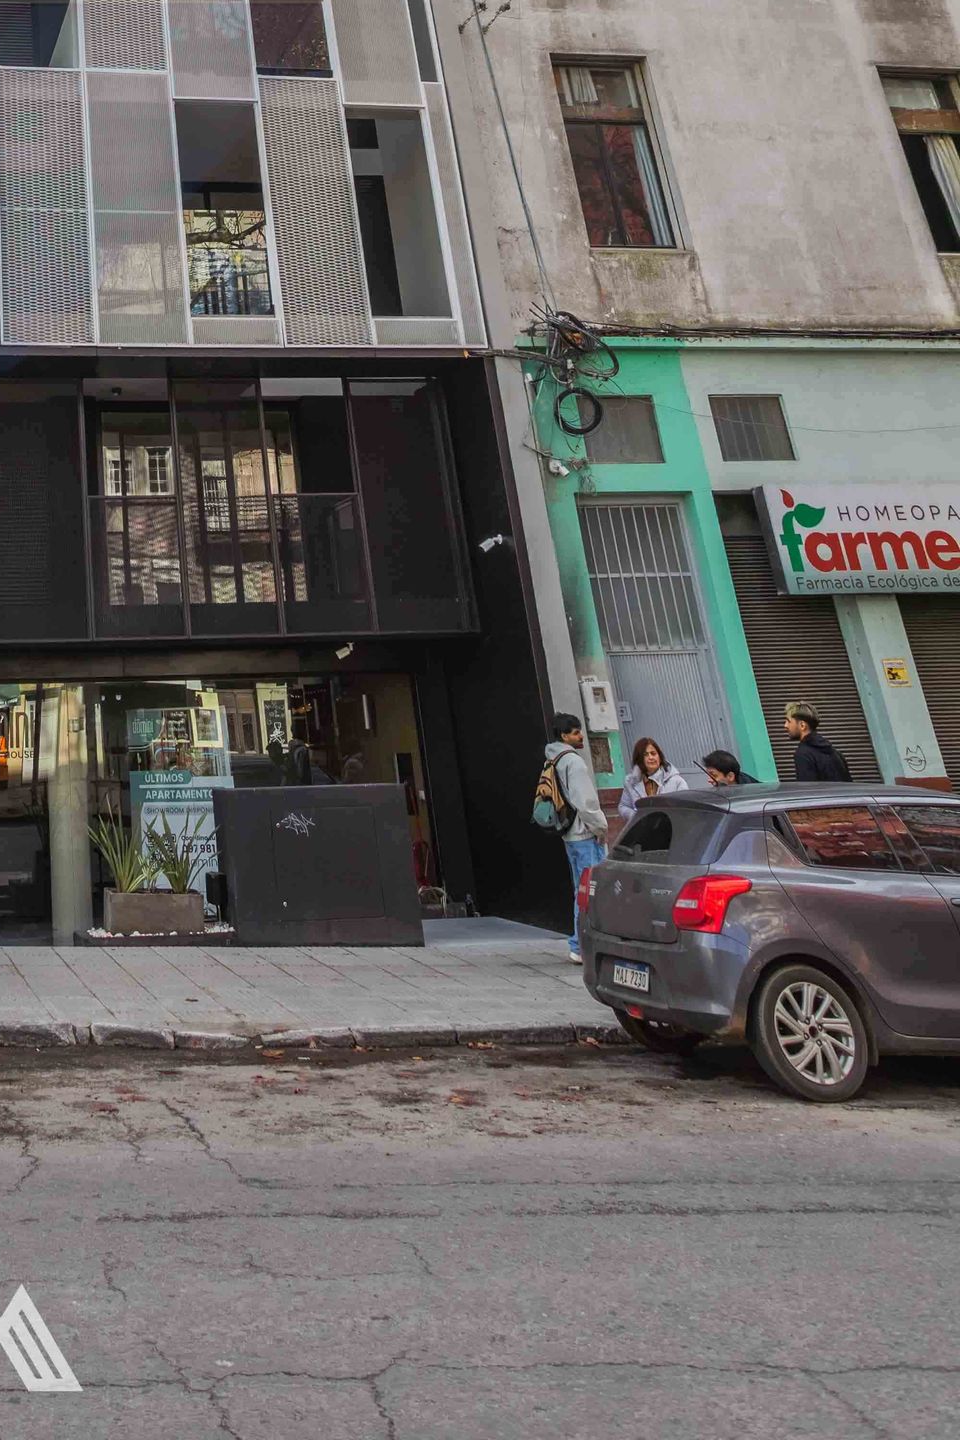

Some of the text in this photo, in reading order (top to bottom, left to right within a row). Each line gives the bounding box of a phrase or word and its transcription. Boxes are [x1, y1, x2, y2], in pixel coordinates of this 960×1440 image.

[780, 503, 960, 572] farme
[796, 576, 864, 591] Farmacia
[868, 574, 939, 591] Ecológica
[144, 772, 184, 783] ÚLTIMOS
[200, 844, 215, 853] 981
